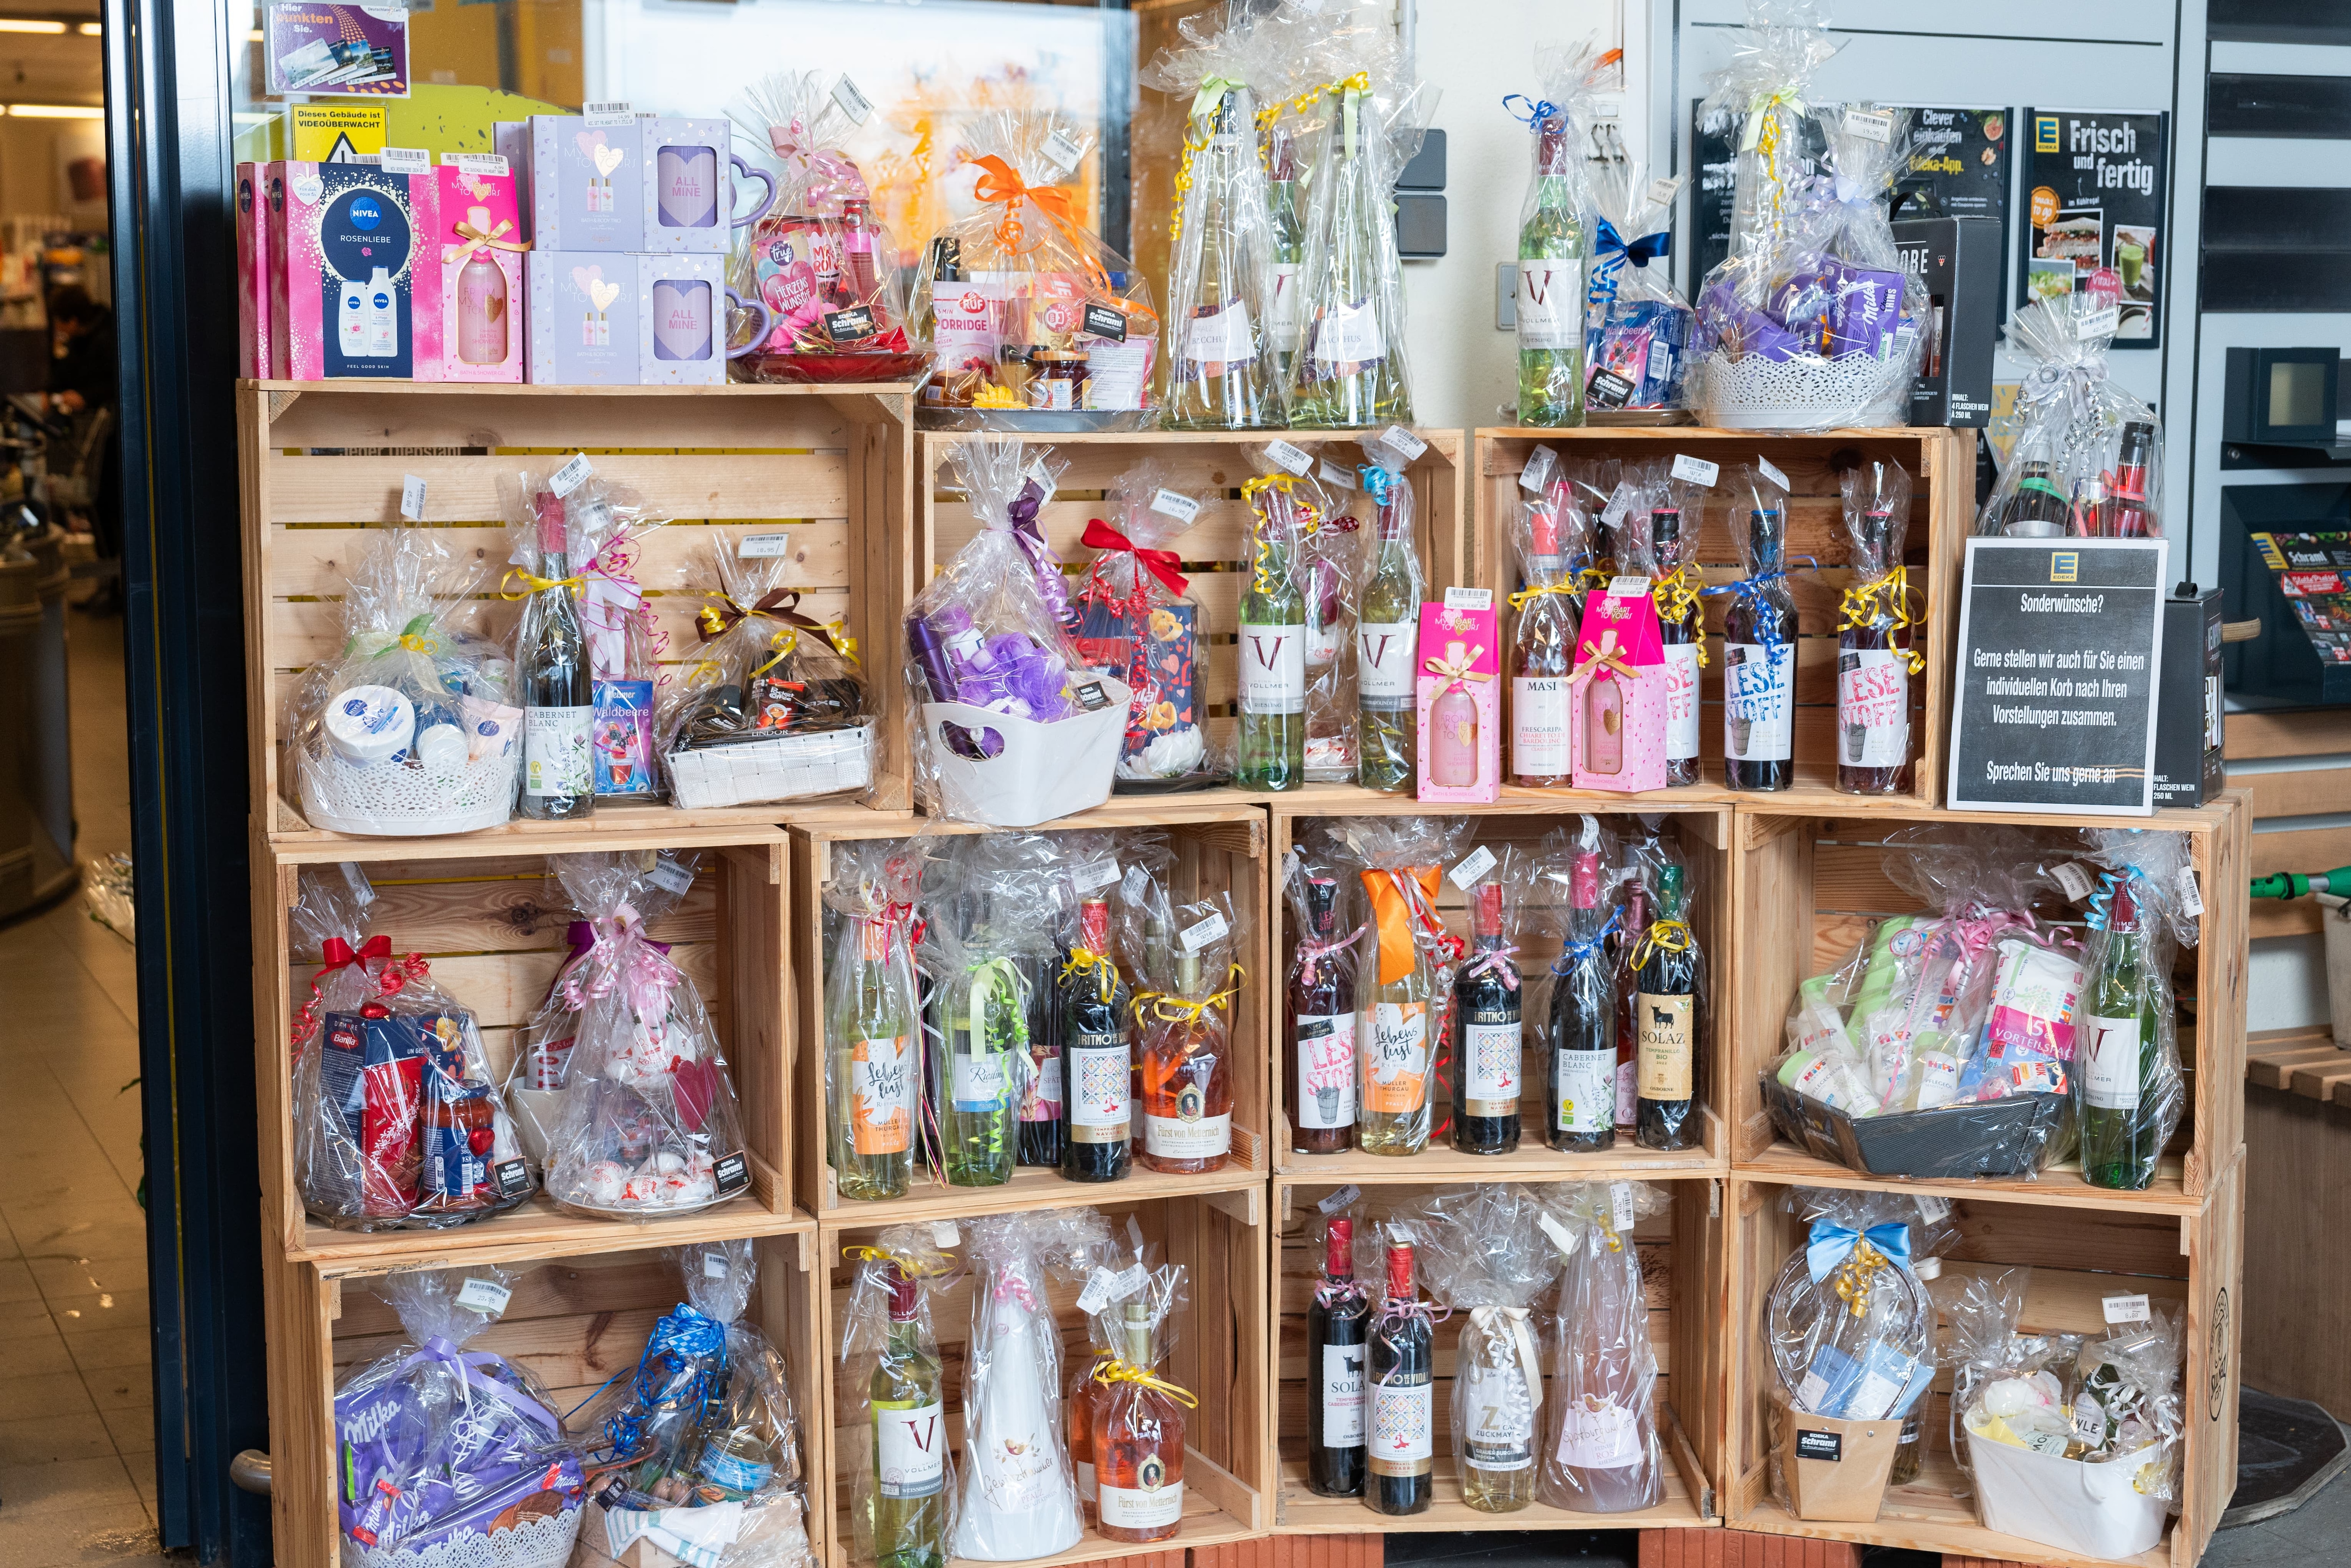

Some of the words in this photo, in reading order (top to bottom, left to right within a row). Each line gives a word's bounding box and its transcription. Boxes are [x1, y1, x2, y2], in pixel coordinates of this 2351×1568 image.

[276, 13, 333, 24] punkten
[299, 119, 380, 128] VIDEOÜBERWACHT
[1923, 109, 1955, 126] Clever
[572, 137, 608, 147] FROM
[1913, 128, 1962, 143] einkaufen
[2069, 119, 2136, 154] Frisch
[1909, 156, 1964, 175] Edeka-App.
[2074, 153, 2094, 170] und
[676, 176, 698, 186] ALL
[2097, 158, 2154, 197] fertig
[672, 187, 701, 197] MINE
[2034, 197, 2054, 205] snacks
[2076, 196, 2100, 206] Kühlregal
[352, 208, 379, 218] NIVEA
[2033, 206, 2041, 215] to
[2042, 207, 2052, 221] go
[340, 235, 391, 244] ROSENLIEBE
[774, 276, 809, 299] HERZENS
[962, 298, 984, 311] RUF
[1861, 278, 1878, 325] Milka
[1884, 288, 1897, 313] THINS
[672, 310, 694, 319] ALL
[1089, 312, 1123, 328] Schraml
[1097, 308, 1116, 318] EDEKA
[669, 319, 697, 330] MINE
[832, 315, 867, 329] Schraml
[1595, 375, 1628, 395] Schraml
[1606, 374, 1623, 385] EDEKA
[2020, 593, 2104, 614] Sonderwünsche?
[1974, 648, 2002, 667] Gerne
[2004, 649, 2036, 668] stellen
[2039, 651, 2054, 669] wir
[2057, 650, 2081, 670] auch
[2083, 651, 2096, 670] für
[2099, 651, 2115, 670] Sie
[2117, 651, 2144, 670] einen
[1527, 682, 1556, 691] MASI
[1727, 661, 1785, 699] LESE
[1840, 662, 1900, 705] LESE
[1987, 676, 2048, 696] individuellen
[2050, 677, 2073, 697] Korb
[2075, 678, 2099, 698] nach
[2102, 678, 2127, 698] Ihren
[770, 686, 795, 698] Pocket
[348, 701, 363, 715] NIVEA
[593, 707, 649, 717] Waldbeere
[1993, 704, 2059, 729] Vorstellungen
[2061, 708, 2117, 726] zusammen.
[1987, 761, 2032, 787] Sprechen
[2034, 761, 2050, 782] Sie
[2052, 765, 2070, 783] uns
[2072, 766, 2101, 787] gerne
[2103, 768, 2116, 783] an
[333, 1033, 357, 1046] Barilla
[1373, 1024, 1417, 1047] Lebens
[1642, 1031, 1685, 1044] SOLAZ
[1383, 1038, 1413, 1061] lust
[1928, 1060, 1955, 1073] HiPP
[2035, 1062, 2046, 1076] NUK
[970, 1067, 1005, 1083] Riesling
[1811, 1064, 1845, 1096] PFLEGECREME
[1158, 1125, 1173, 1137] Fürst
[1175, 1128, 1186, 1137] von
[1187, 1125, 1219, 1138] Metternich
[717, 1162, 743, 1179] Schraml
[720, 1159, 735, 1169] EDEKA
[501, 1166, 525, 1181] Schraml
[1411, 1371, 1428, 1384] VIDA!
[1331, 1380, 1365, 1393] SOLA
[344, 1399, 402, 1444] Milka
[1480, 1406, 1500, 1430] Z
[900, 1413, 939, 1453] V
[1801, 1437, 1837, 1447] Schraml
[1599, 1451, 1634, 1466] RHEINHESSEN
[905, 1461, 940, 1473] VOLLMER
[553, 1473, 579, 1487] Milka
[1118, 1496, 1134, 1508] Fürst
[1136, 1499, 1147, 1508] von
[1149, 1494, 1177, 1508] Metternich
[365, 1497, 384, 1531] Milka
